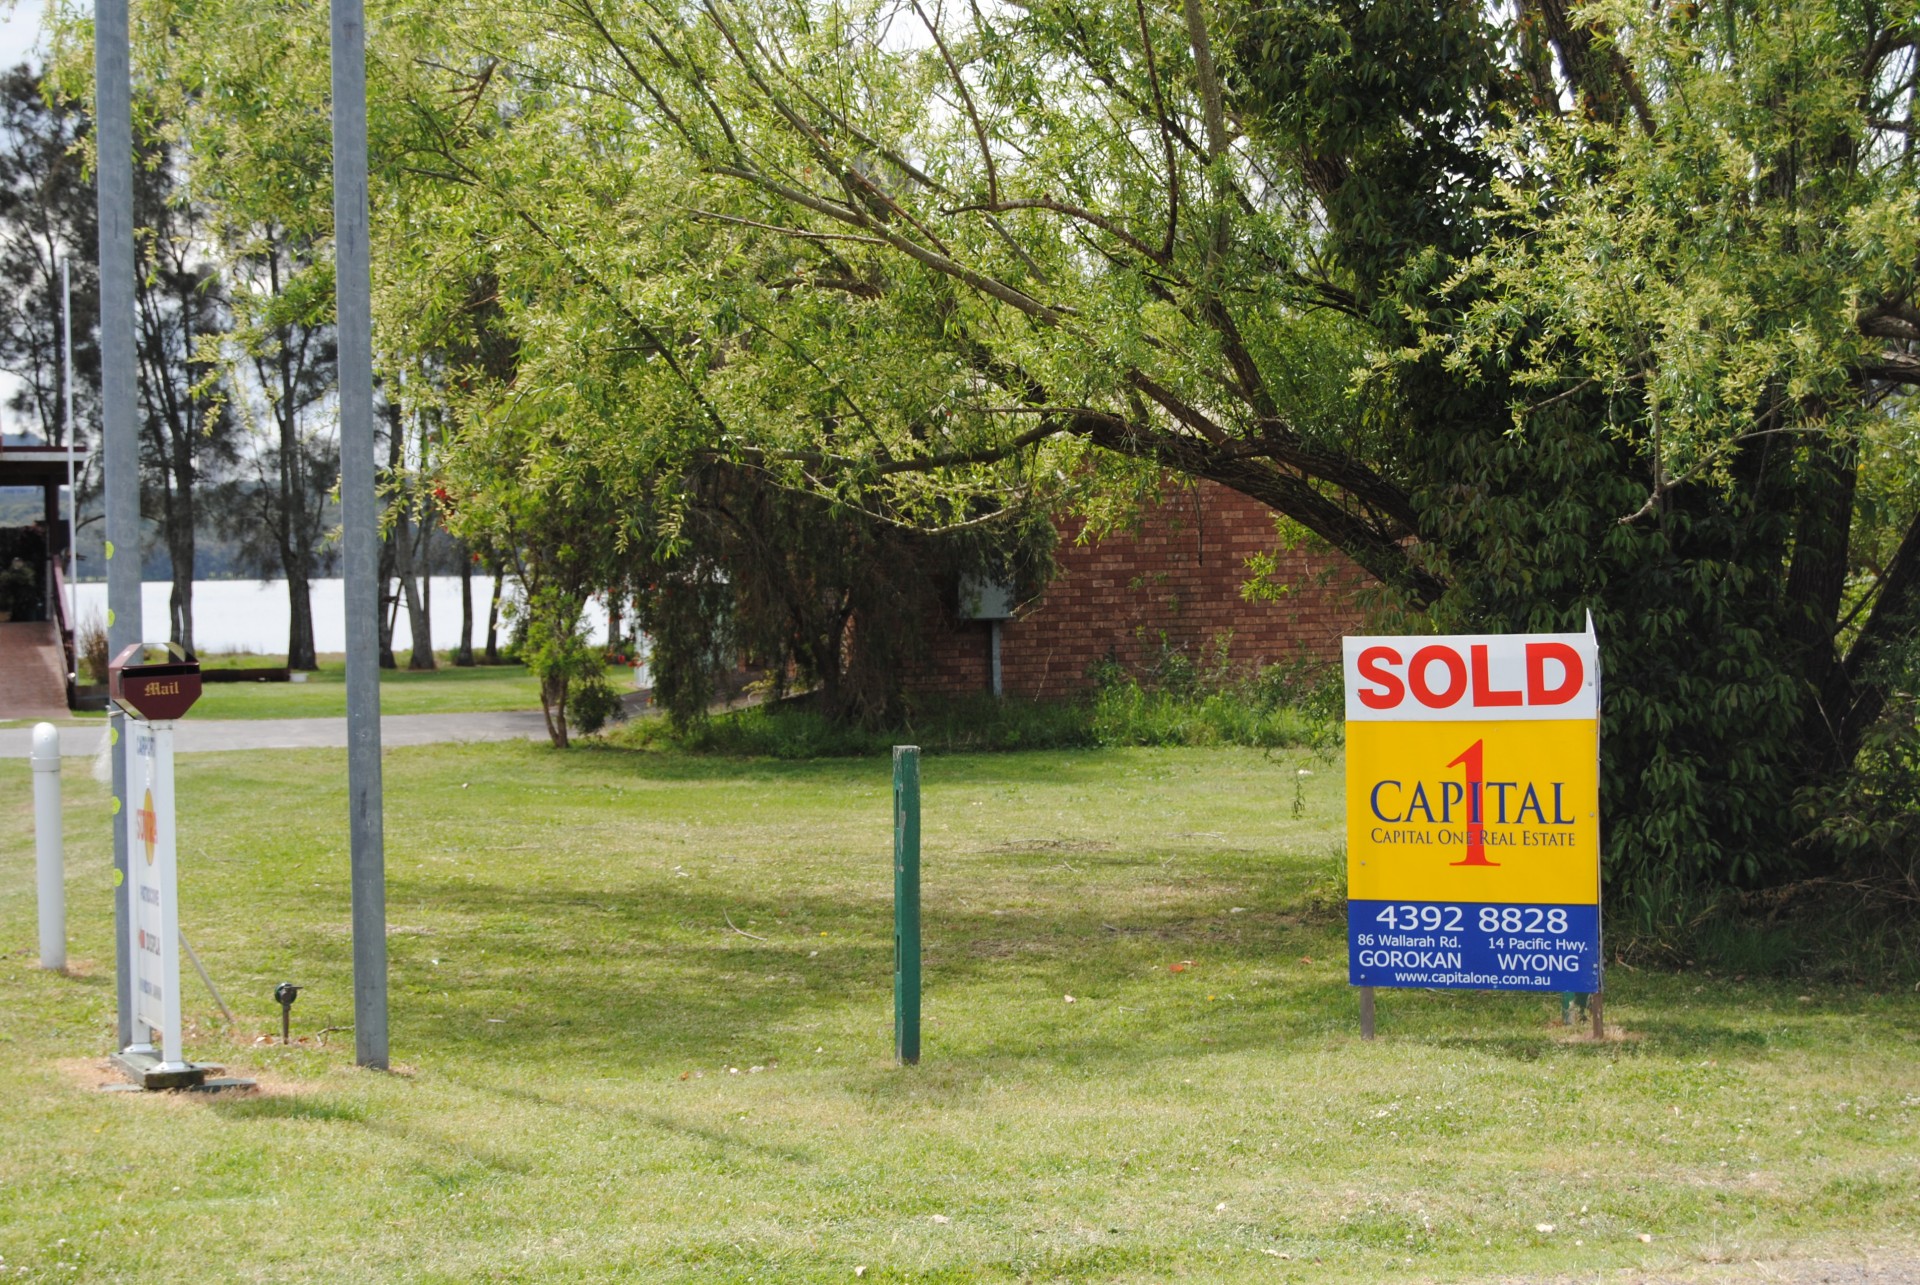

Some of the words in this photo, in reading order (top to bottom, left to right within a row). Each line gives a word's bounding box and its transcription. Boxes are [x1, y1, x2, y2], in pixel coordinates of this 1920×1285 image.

[1356, 642, 1584, 709] SOLD
[144, 681, 180, 697] Mail
[1370, 780, 1575, 825] CAPITAL
[1371, 828, 1433, 844] CAPITAL
[1438, 829, 1474, 846] ONE
[1479, 830, 1516, 846] REAL
[1523, 830, 1576, 847] ESTATE
[1375, 905, 1464, 932] 4392
[1478, 907, 1568, 934] 8828
[1357, 934, 1374, 946] 86
[1378, 934, 1435, 948] Wallarah
[1440, 936, 1462, 948] Rd.
[1488, 937, 1504, 949] 14
[1509, 937, 1552, 950] Pacific
[1556, 939, 1588, 954] Hwy.
[1358, 950, 1462, 969] GOROKAN
[1497, 953, 1580, 972] WYONG
[1395, 971, 1551, 986] www.capitalone.com.au
